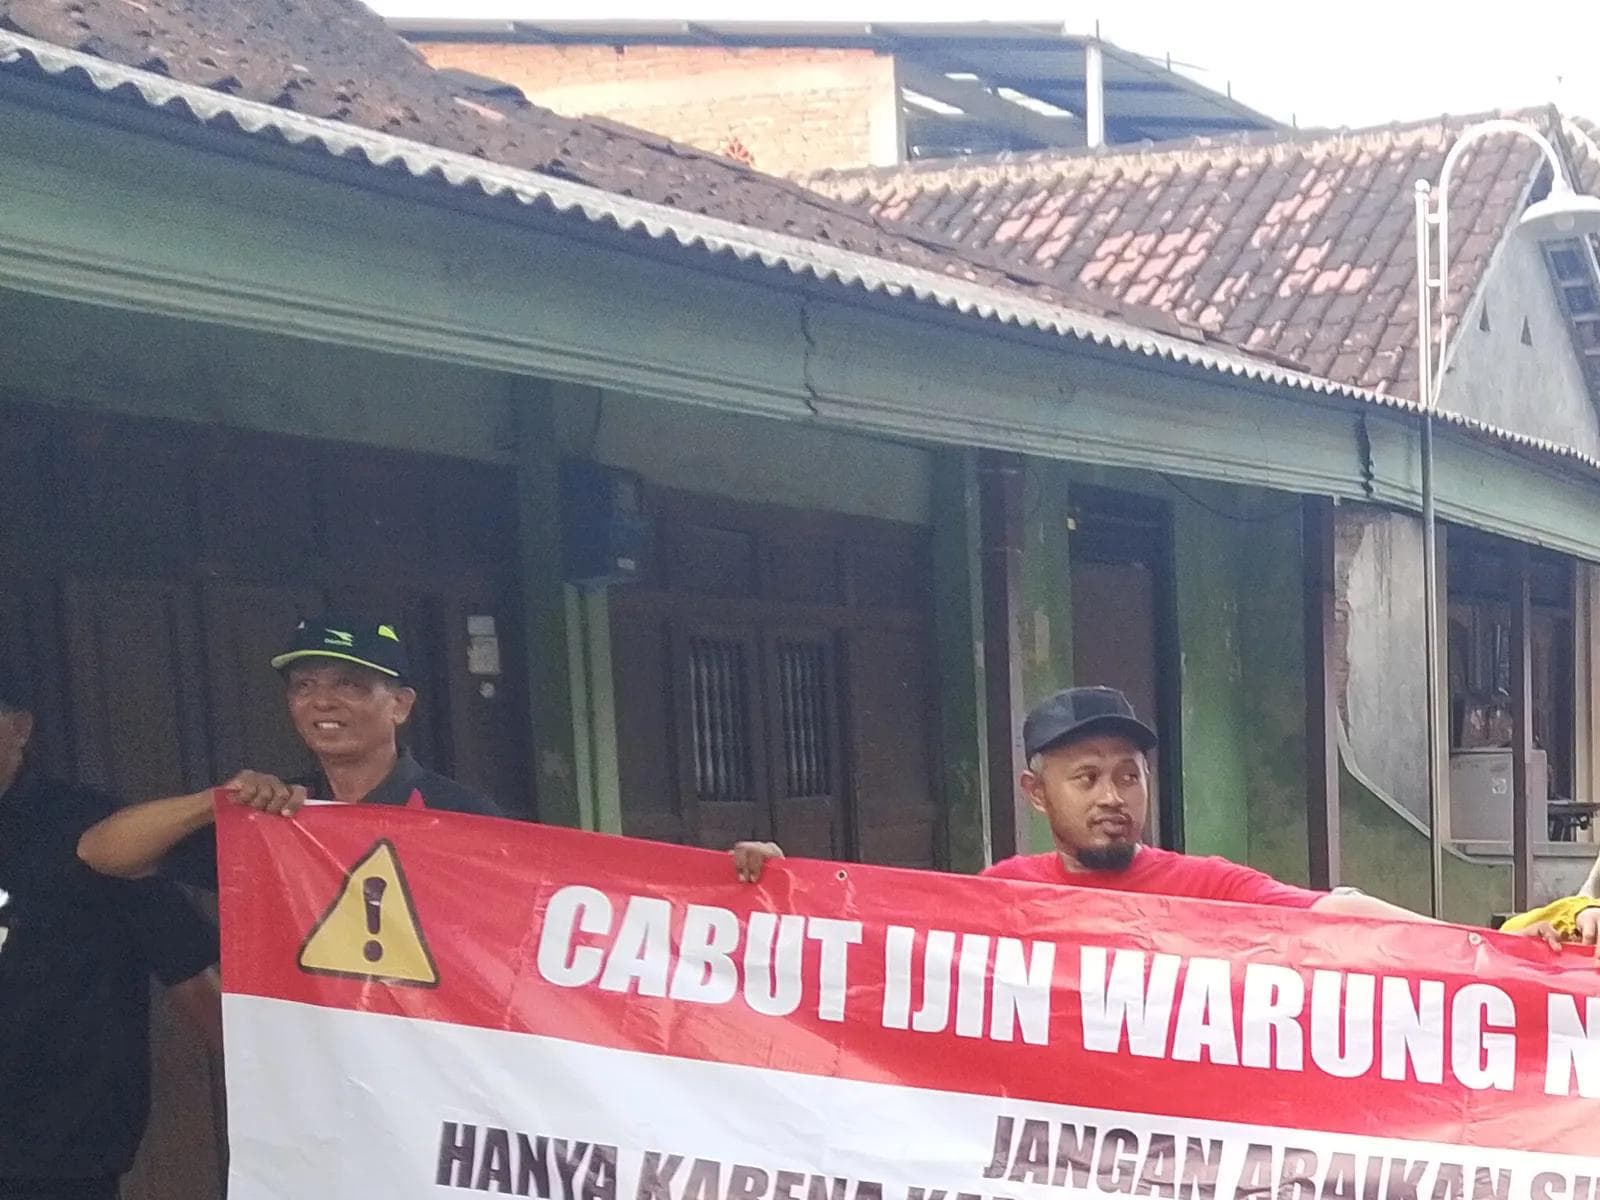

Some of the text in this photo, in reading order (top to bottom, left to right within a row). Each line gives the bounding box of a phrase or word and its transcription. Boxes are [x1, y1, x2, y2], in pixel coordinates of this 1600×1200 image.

[537, 886, 863, 1022] CABUT
[882, 926, 1056, 1046] IJIN
[1079, 947, 1520, 1092] WARUNG
